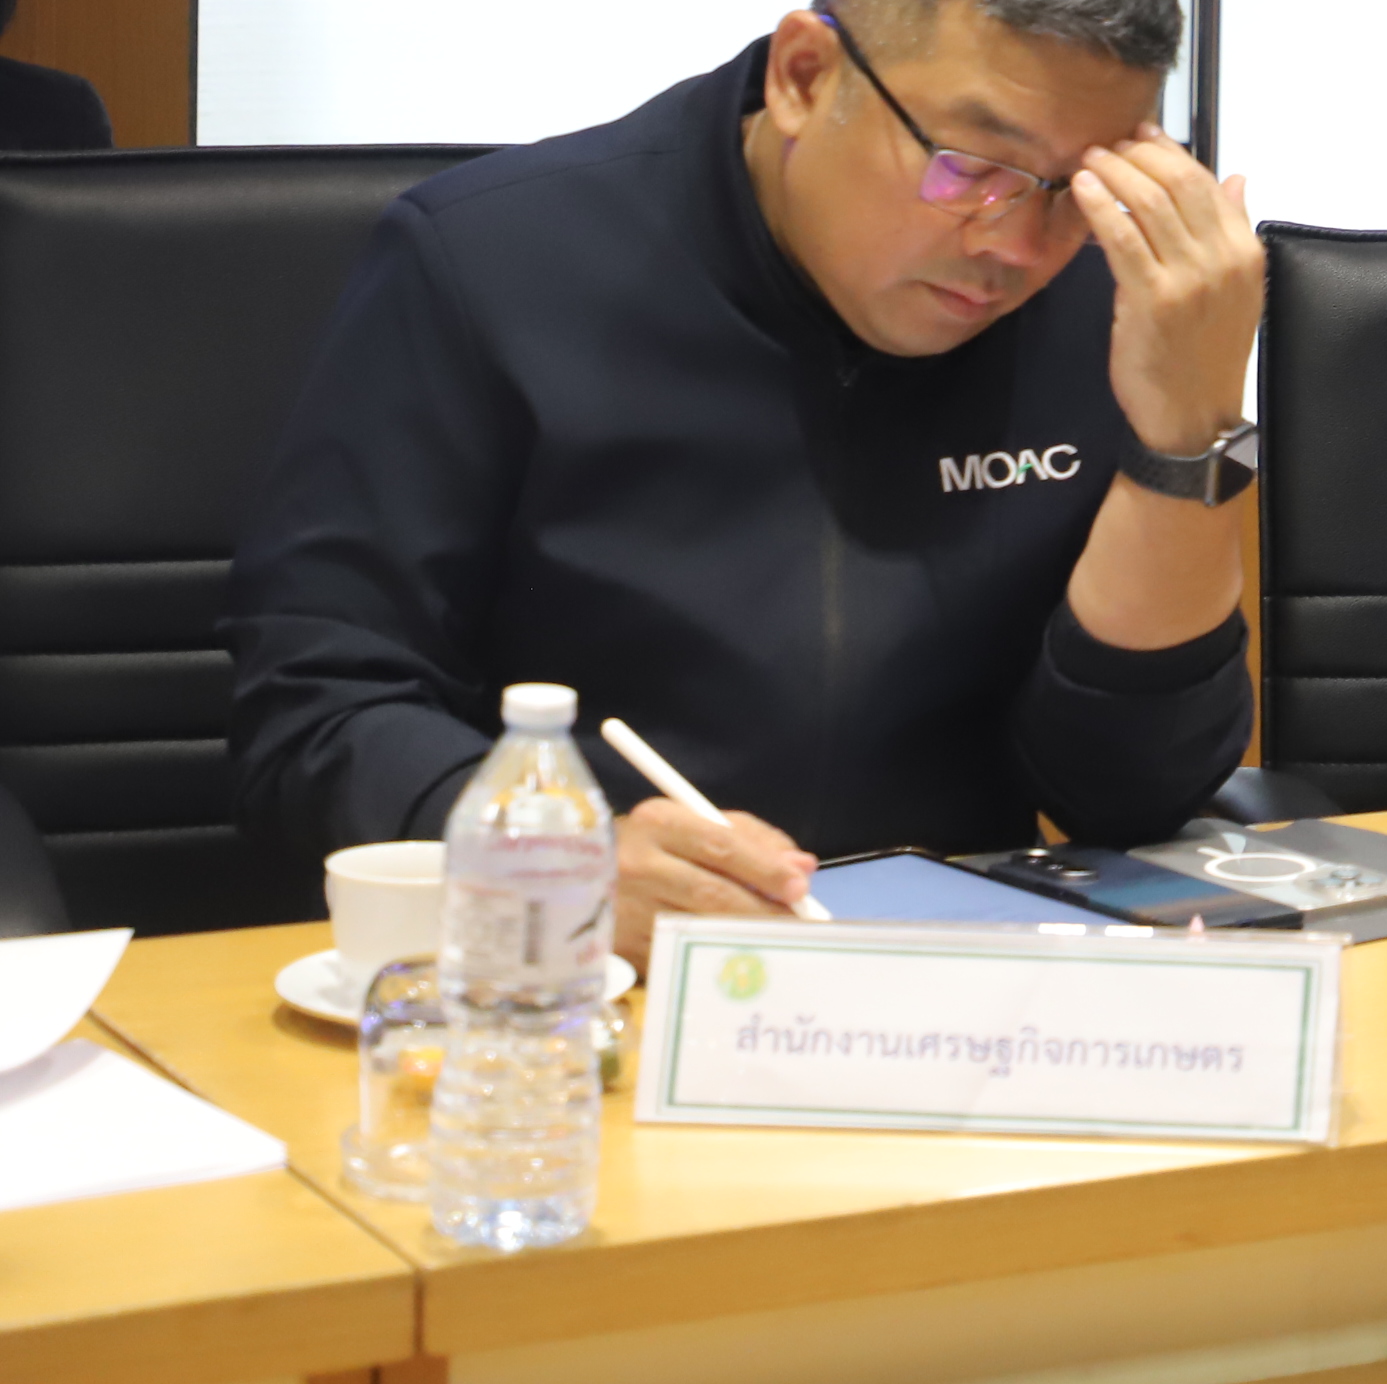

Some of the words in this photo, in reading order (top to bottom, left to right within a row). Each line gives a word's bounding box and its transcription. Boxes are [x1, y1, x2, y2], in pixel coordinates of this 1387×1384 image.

[938, 443, 1082, 493] MOAC
[734, 1012, 1246, 1077] สำนักงานเศรษฐกิจการเกษตร
